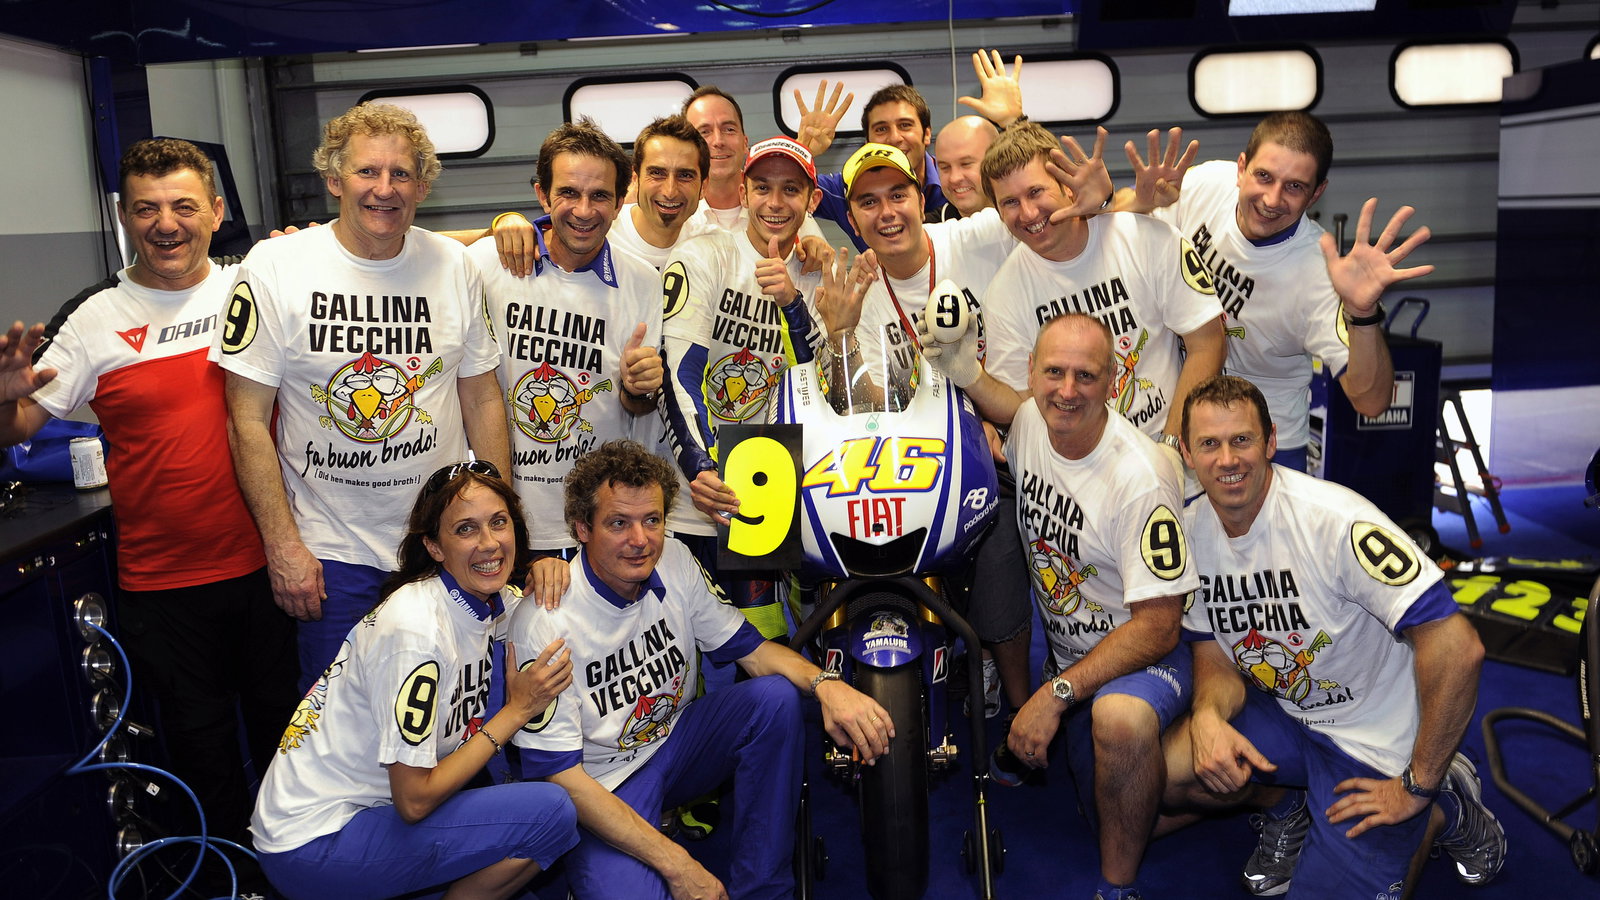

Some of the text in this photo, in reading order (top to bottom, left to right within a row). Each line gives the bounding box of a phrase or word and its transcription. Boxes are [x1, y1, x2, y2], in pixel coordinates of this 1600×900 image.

[310, 290, 432, 323] GALLINA
[663, 271, 684, 314] 9
[936, 294, 960, 329] 9
[222, 293, 252, 346] 9
[308, 323, 433, 355] VECCHIA
[506, 302, 606, 347] GALLINA
[711, 314, 786, 355] VECCHI
[507, 331, 604, 374] VECCHIA
[301, 427, 438, 478] fa buon brodo!
[512, 442, 552, 467] buon
[802, 436, 947, 499] 46
[330, 474, 344, 484] hen
[345, 477, 370, 488] makes
[372, 479, 392, 489] good
[523, 474, 546, 484] makes
[547, 475, 564, 485] good
[724, 436, 797, 557] 9
[847, 497, 907, 540] FIAT
[1149, 519, 1181, 571] 9
[1358, 530, 1414, 580] 9
[456, 595, 480, 620] YAMAHA
[1490, 580, 1552, 621] 2
[585, 618, 676, 688] GALLNA
[865, 637, 908, 650] YAMALUBE
[589, 644, 686, 719] VECCHIA
[403, 674, 437, 735] 9
